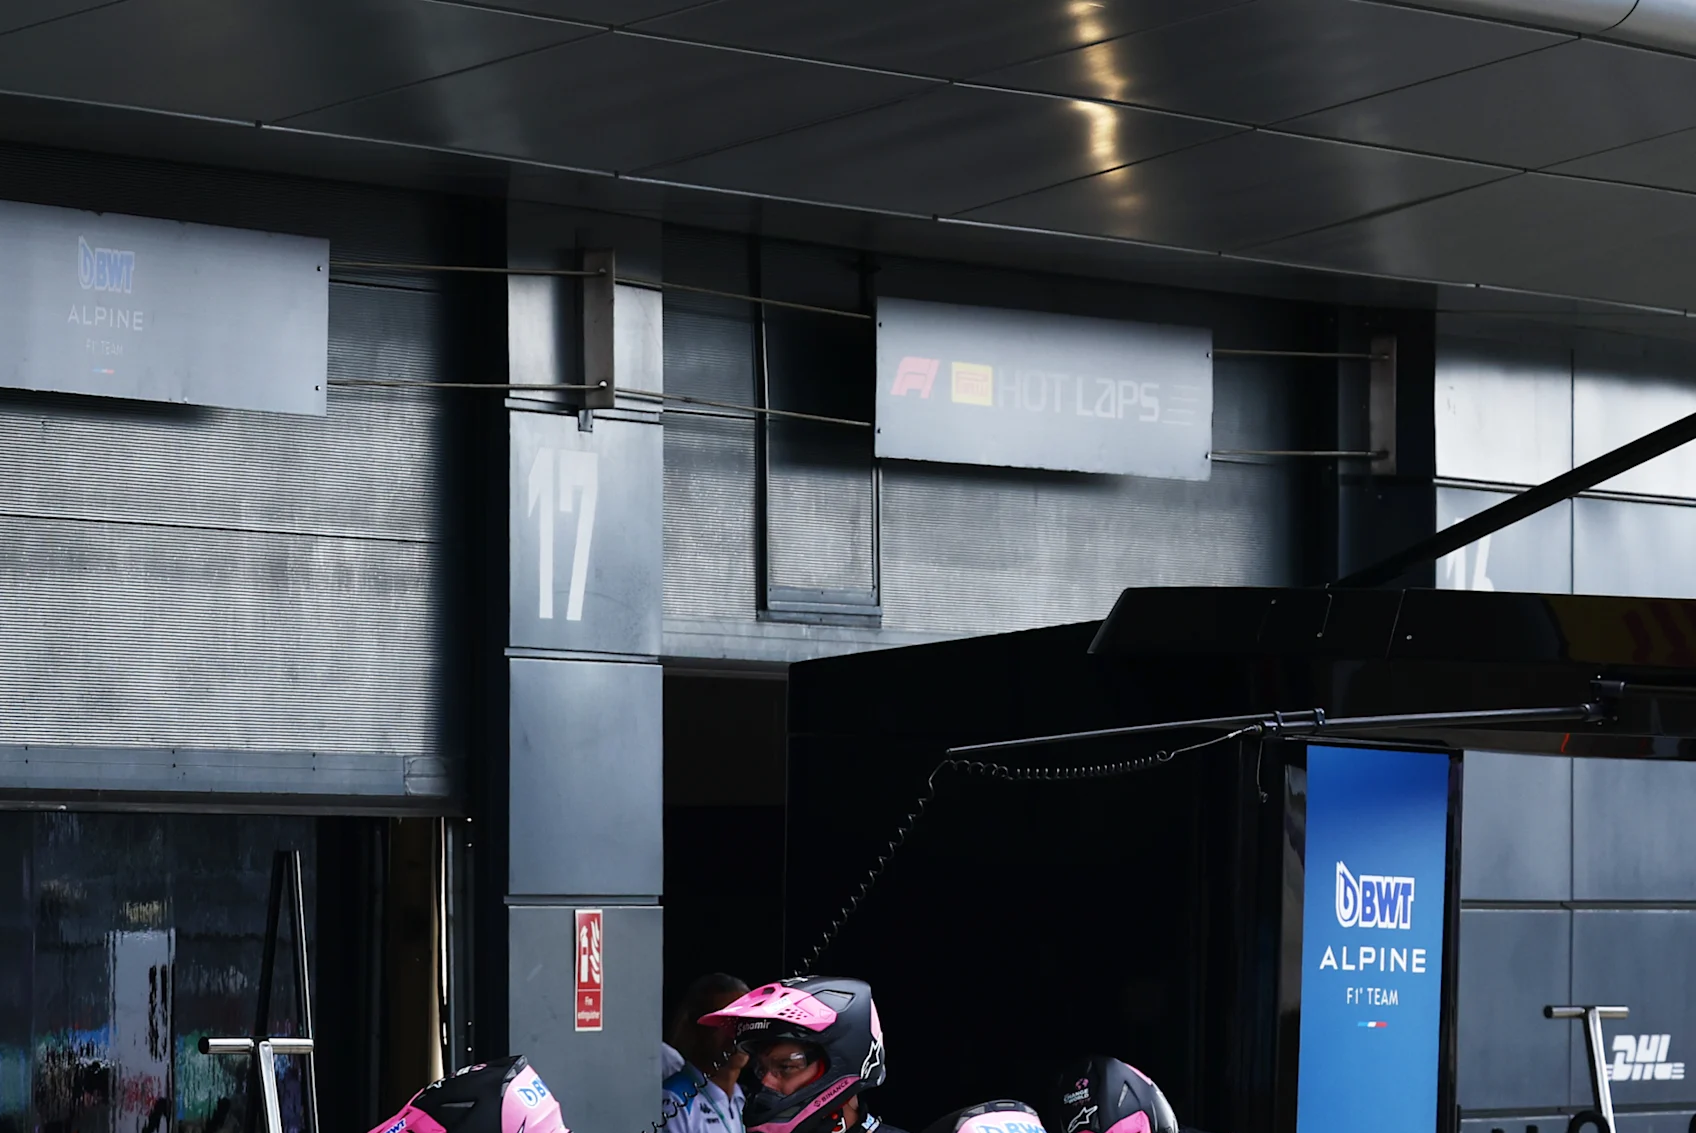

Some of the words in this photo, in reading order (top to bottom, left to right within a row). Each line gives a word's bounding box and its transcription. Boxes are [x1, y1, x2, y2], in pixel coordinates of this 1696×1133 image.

[92, 248, 135, 294] BWT
[67, 303, 144, 332] ALPINE
[997, 367, 1070, 413] HOT
[527, 446, 599, 622] 17
[1359, 875, 1415, 930] BWT
[1319, 945, 1427, 974] ALPINE
[1366, 987, 1399, 1006] TEAM
[1608, 1034, 1678, 1082] DHL
[821, 1079, 849, 1103] BINANCE
